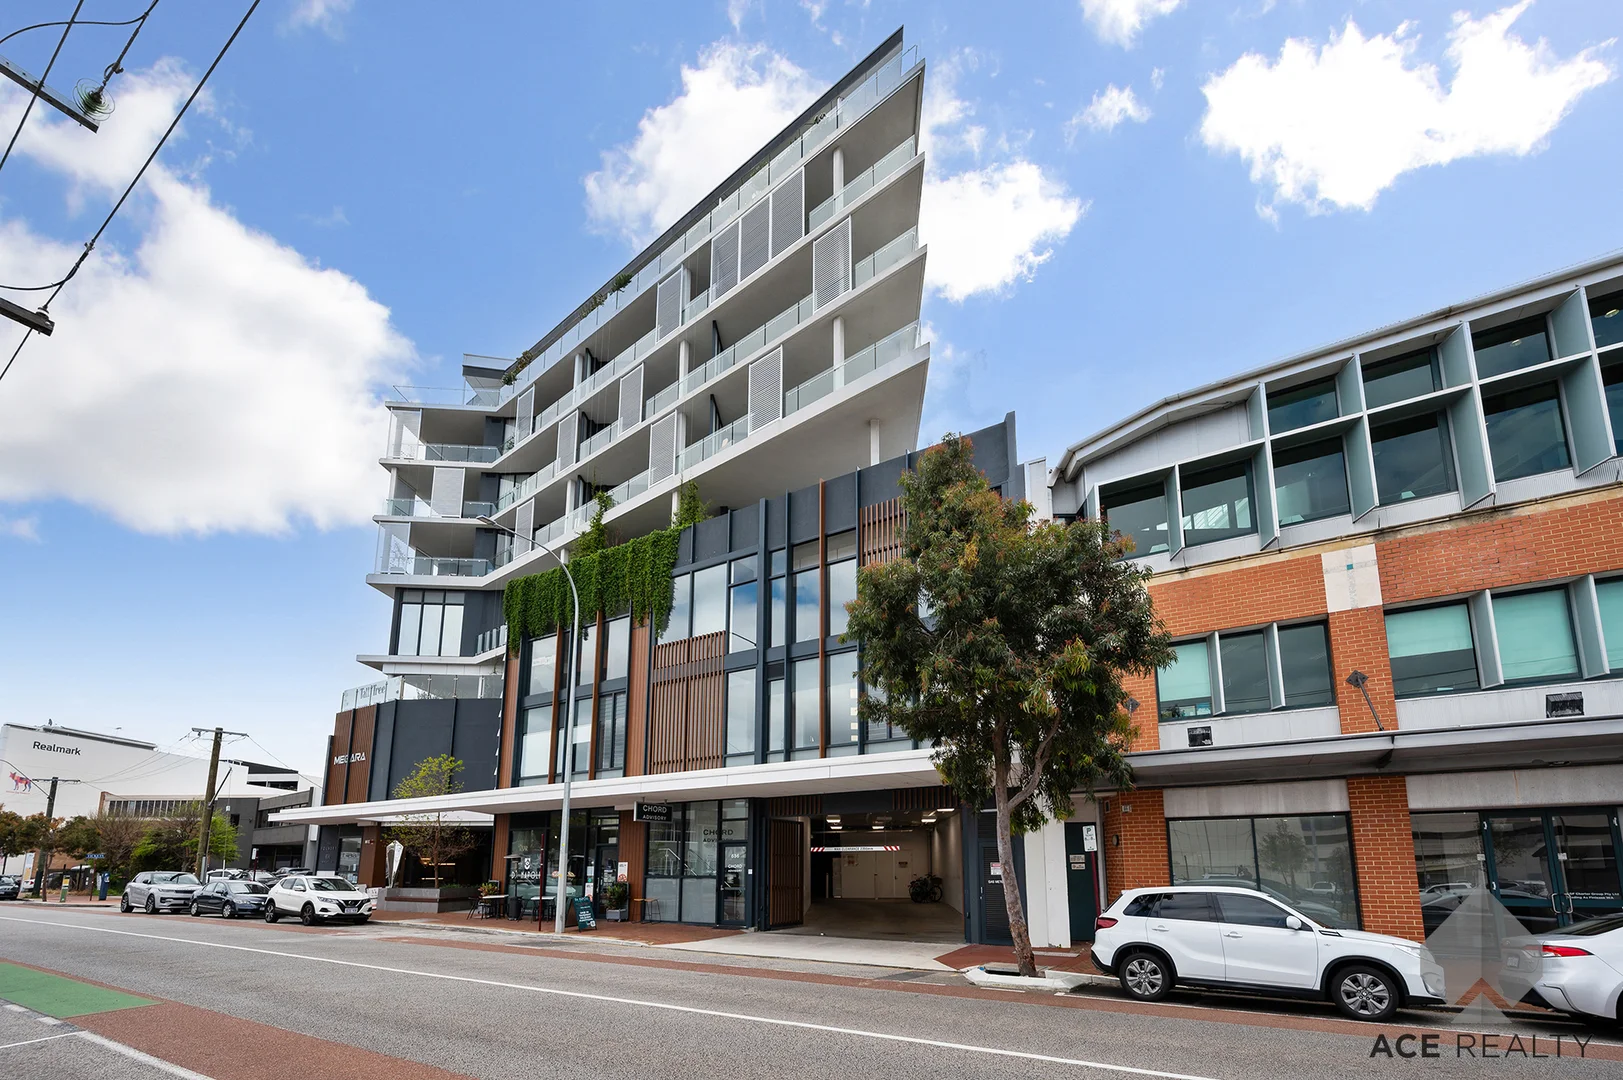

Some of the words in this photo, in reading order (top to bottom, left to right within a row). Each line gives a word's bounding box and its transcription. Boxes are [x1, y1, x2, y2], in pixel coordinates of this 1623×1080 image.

[360, 686, 370, 699] Tall
[372, 684, 386, 696] Tree
[32, 741, 81, 756] Realmark
[642, 804, 667, 813] CHORD
